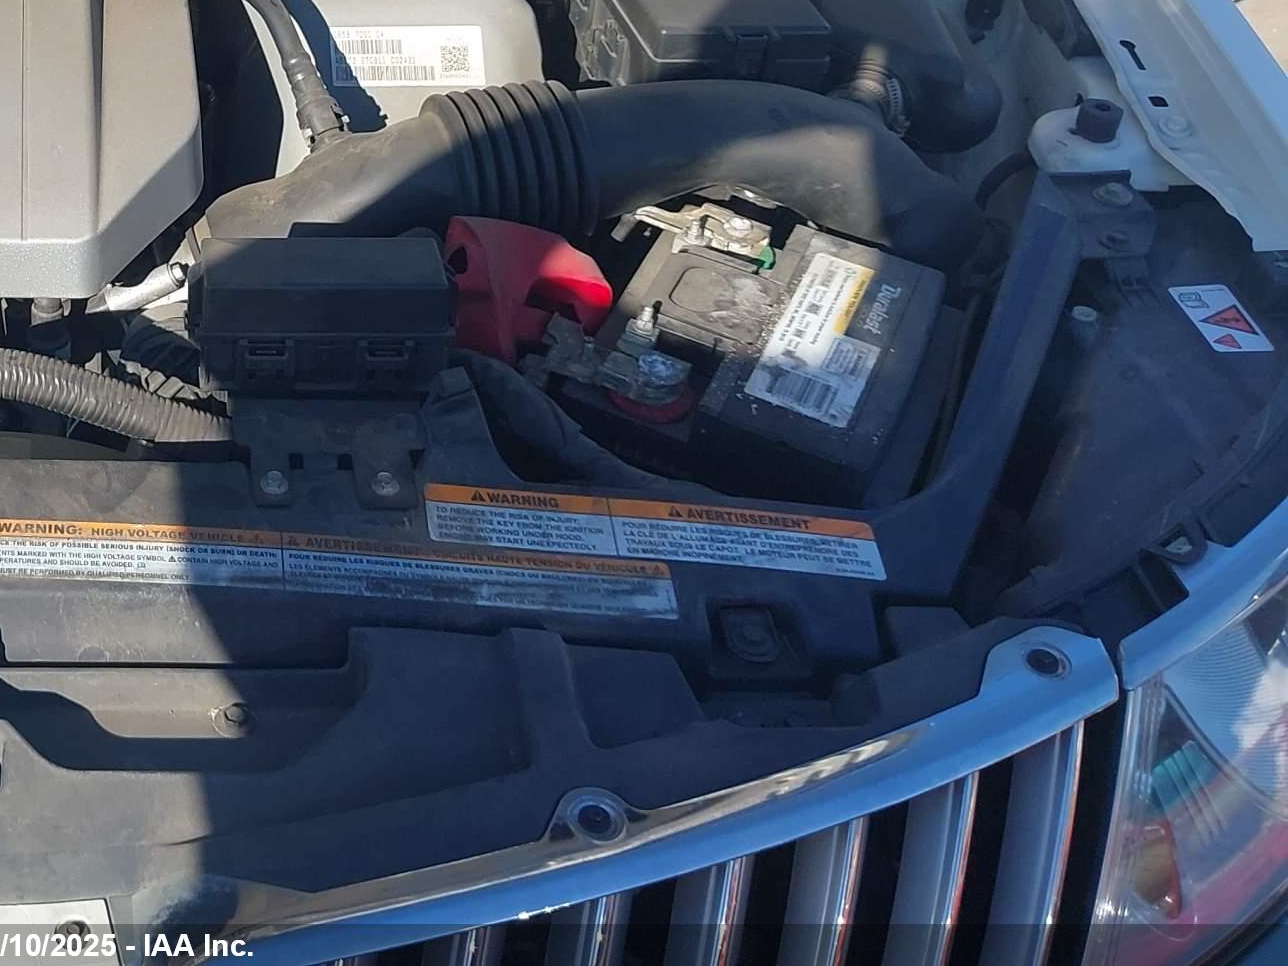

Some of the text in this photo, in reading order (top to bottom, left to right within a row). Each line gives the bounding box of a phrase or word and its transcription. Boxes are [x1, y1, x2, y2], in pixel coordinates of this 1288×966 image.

[863, 284, 902, 334] Duralast
[487, 492, 559, 508] WARNING
[490, 510, 505, 518] THE
[688, 508, 810, 530] AVERTISSEMENT
[517, 521, 542, 530] FROM
[92, 528, 123, 536] HIGH
[127, 529, 186, 540] VOLTAGE
[496, 536, 523, 546] START
[104, 552, 135, 560] VOLTAGE
[137, 553, 166, 562] SYMBOL
